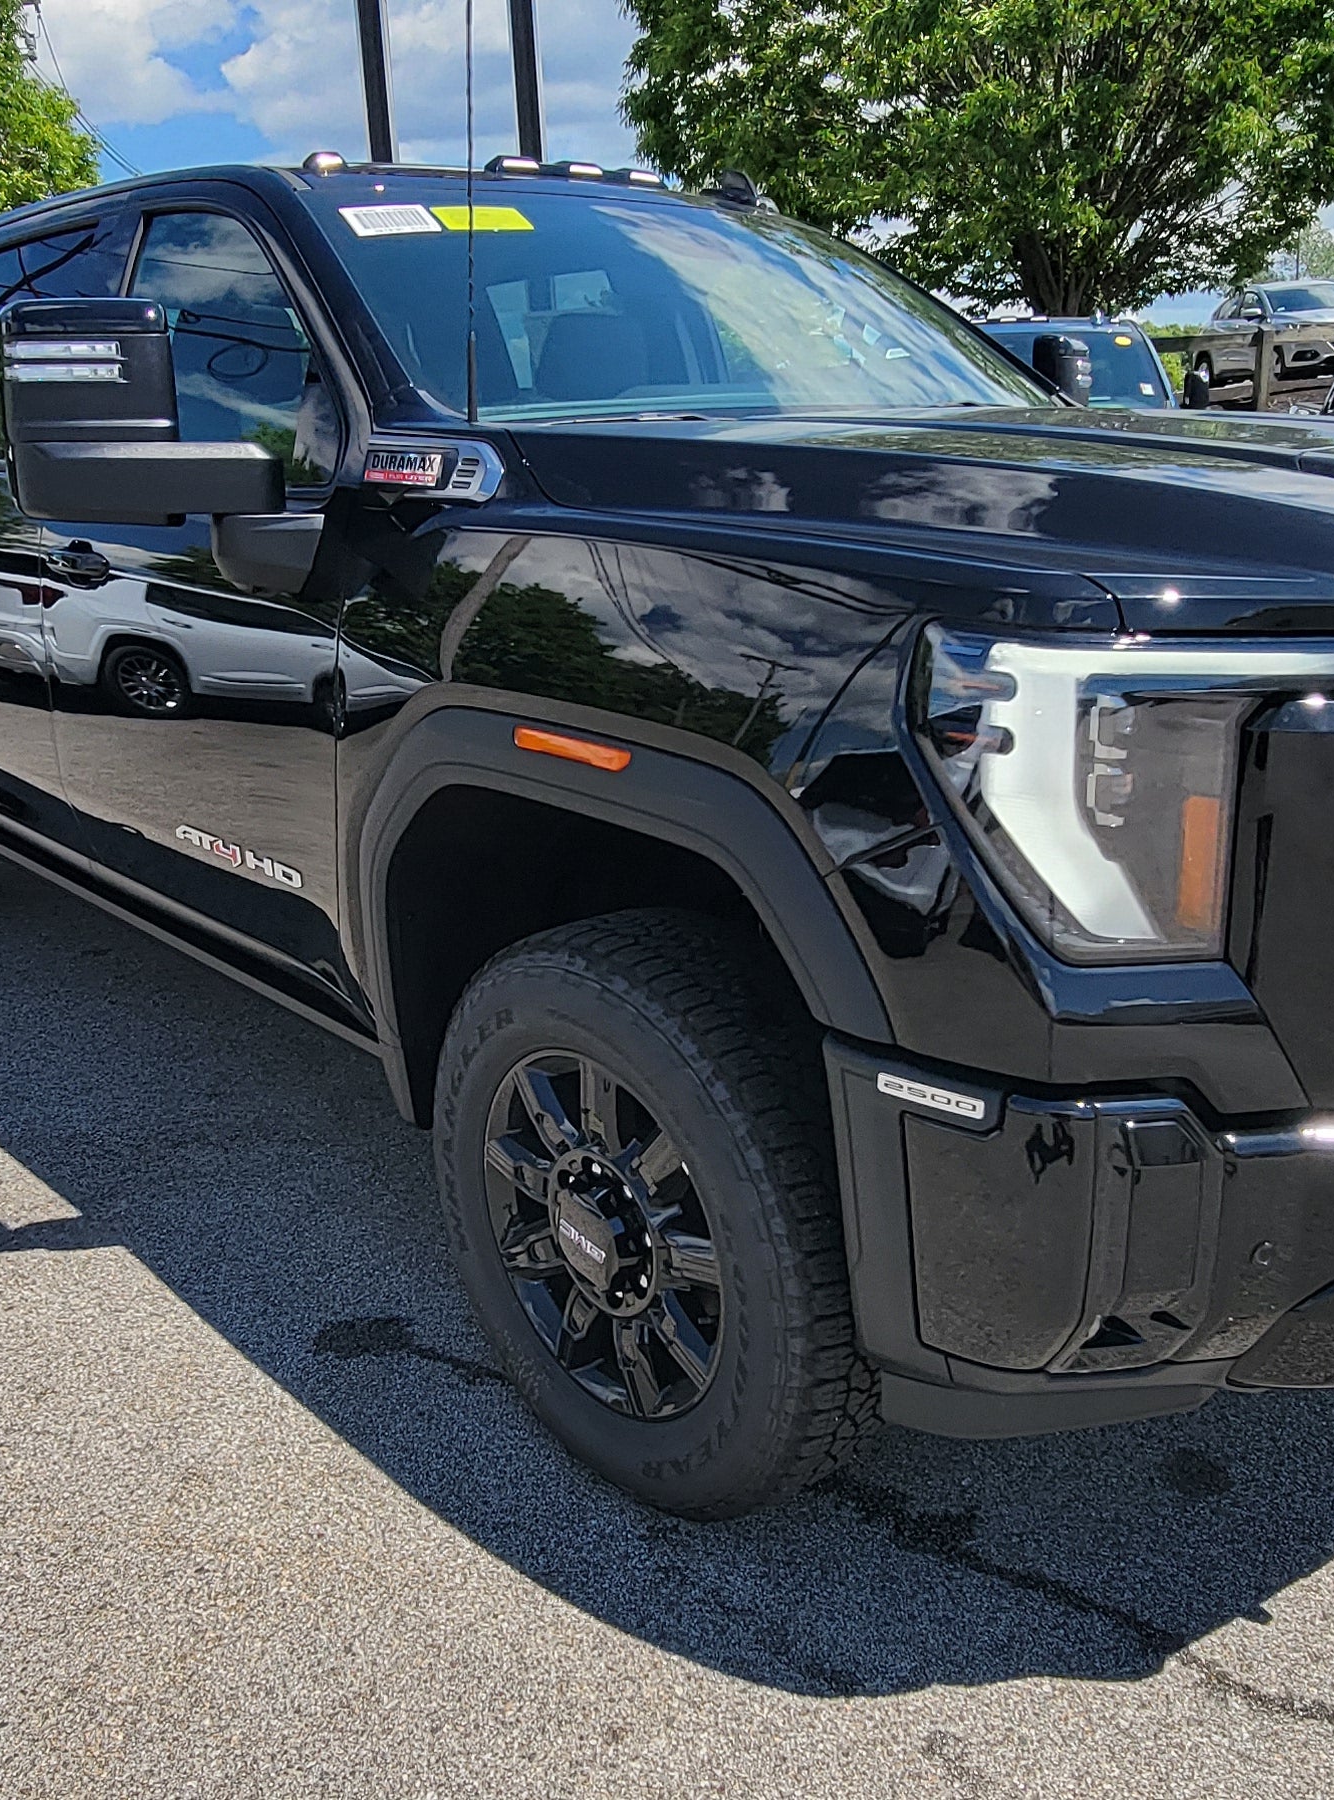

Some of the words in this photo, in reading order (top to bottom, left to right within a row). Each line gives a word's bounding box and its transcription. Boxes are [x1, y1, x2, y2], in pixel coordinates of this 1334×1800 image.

[371, 454, 436, 472] DURAMAX
[175, 824, 243, 868] AT4
[245, 849, 304, 888] HD
[883, 1080, 977, 1112] 2500
[559, 1218, 607, 1264] GMC
